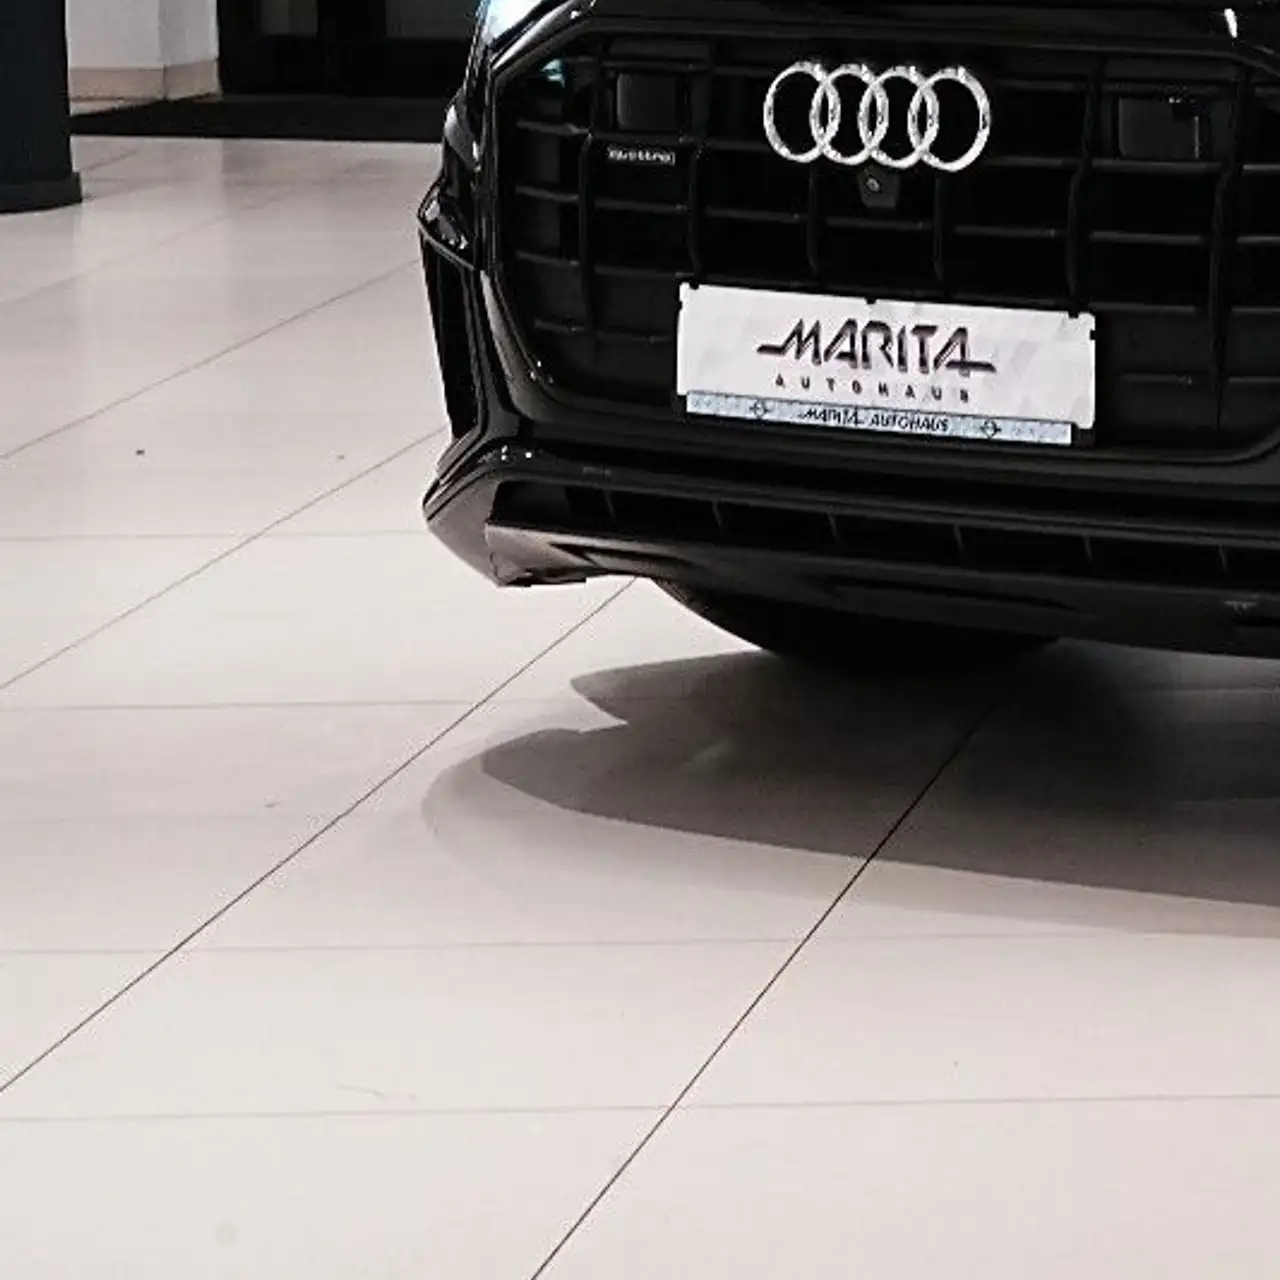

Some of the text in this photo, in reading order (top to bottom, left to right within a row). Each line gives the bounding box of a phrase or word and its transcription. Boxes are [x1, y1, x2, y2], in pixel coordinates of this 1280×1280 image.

[757, 318, 996, 378] MARITA
[775, 374, 970, 403] AUTOHAUS
[869, 415, 950, 433] AUTOHAUS
